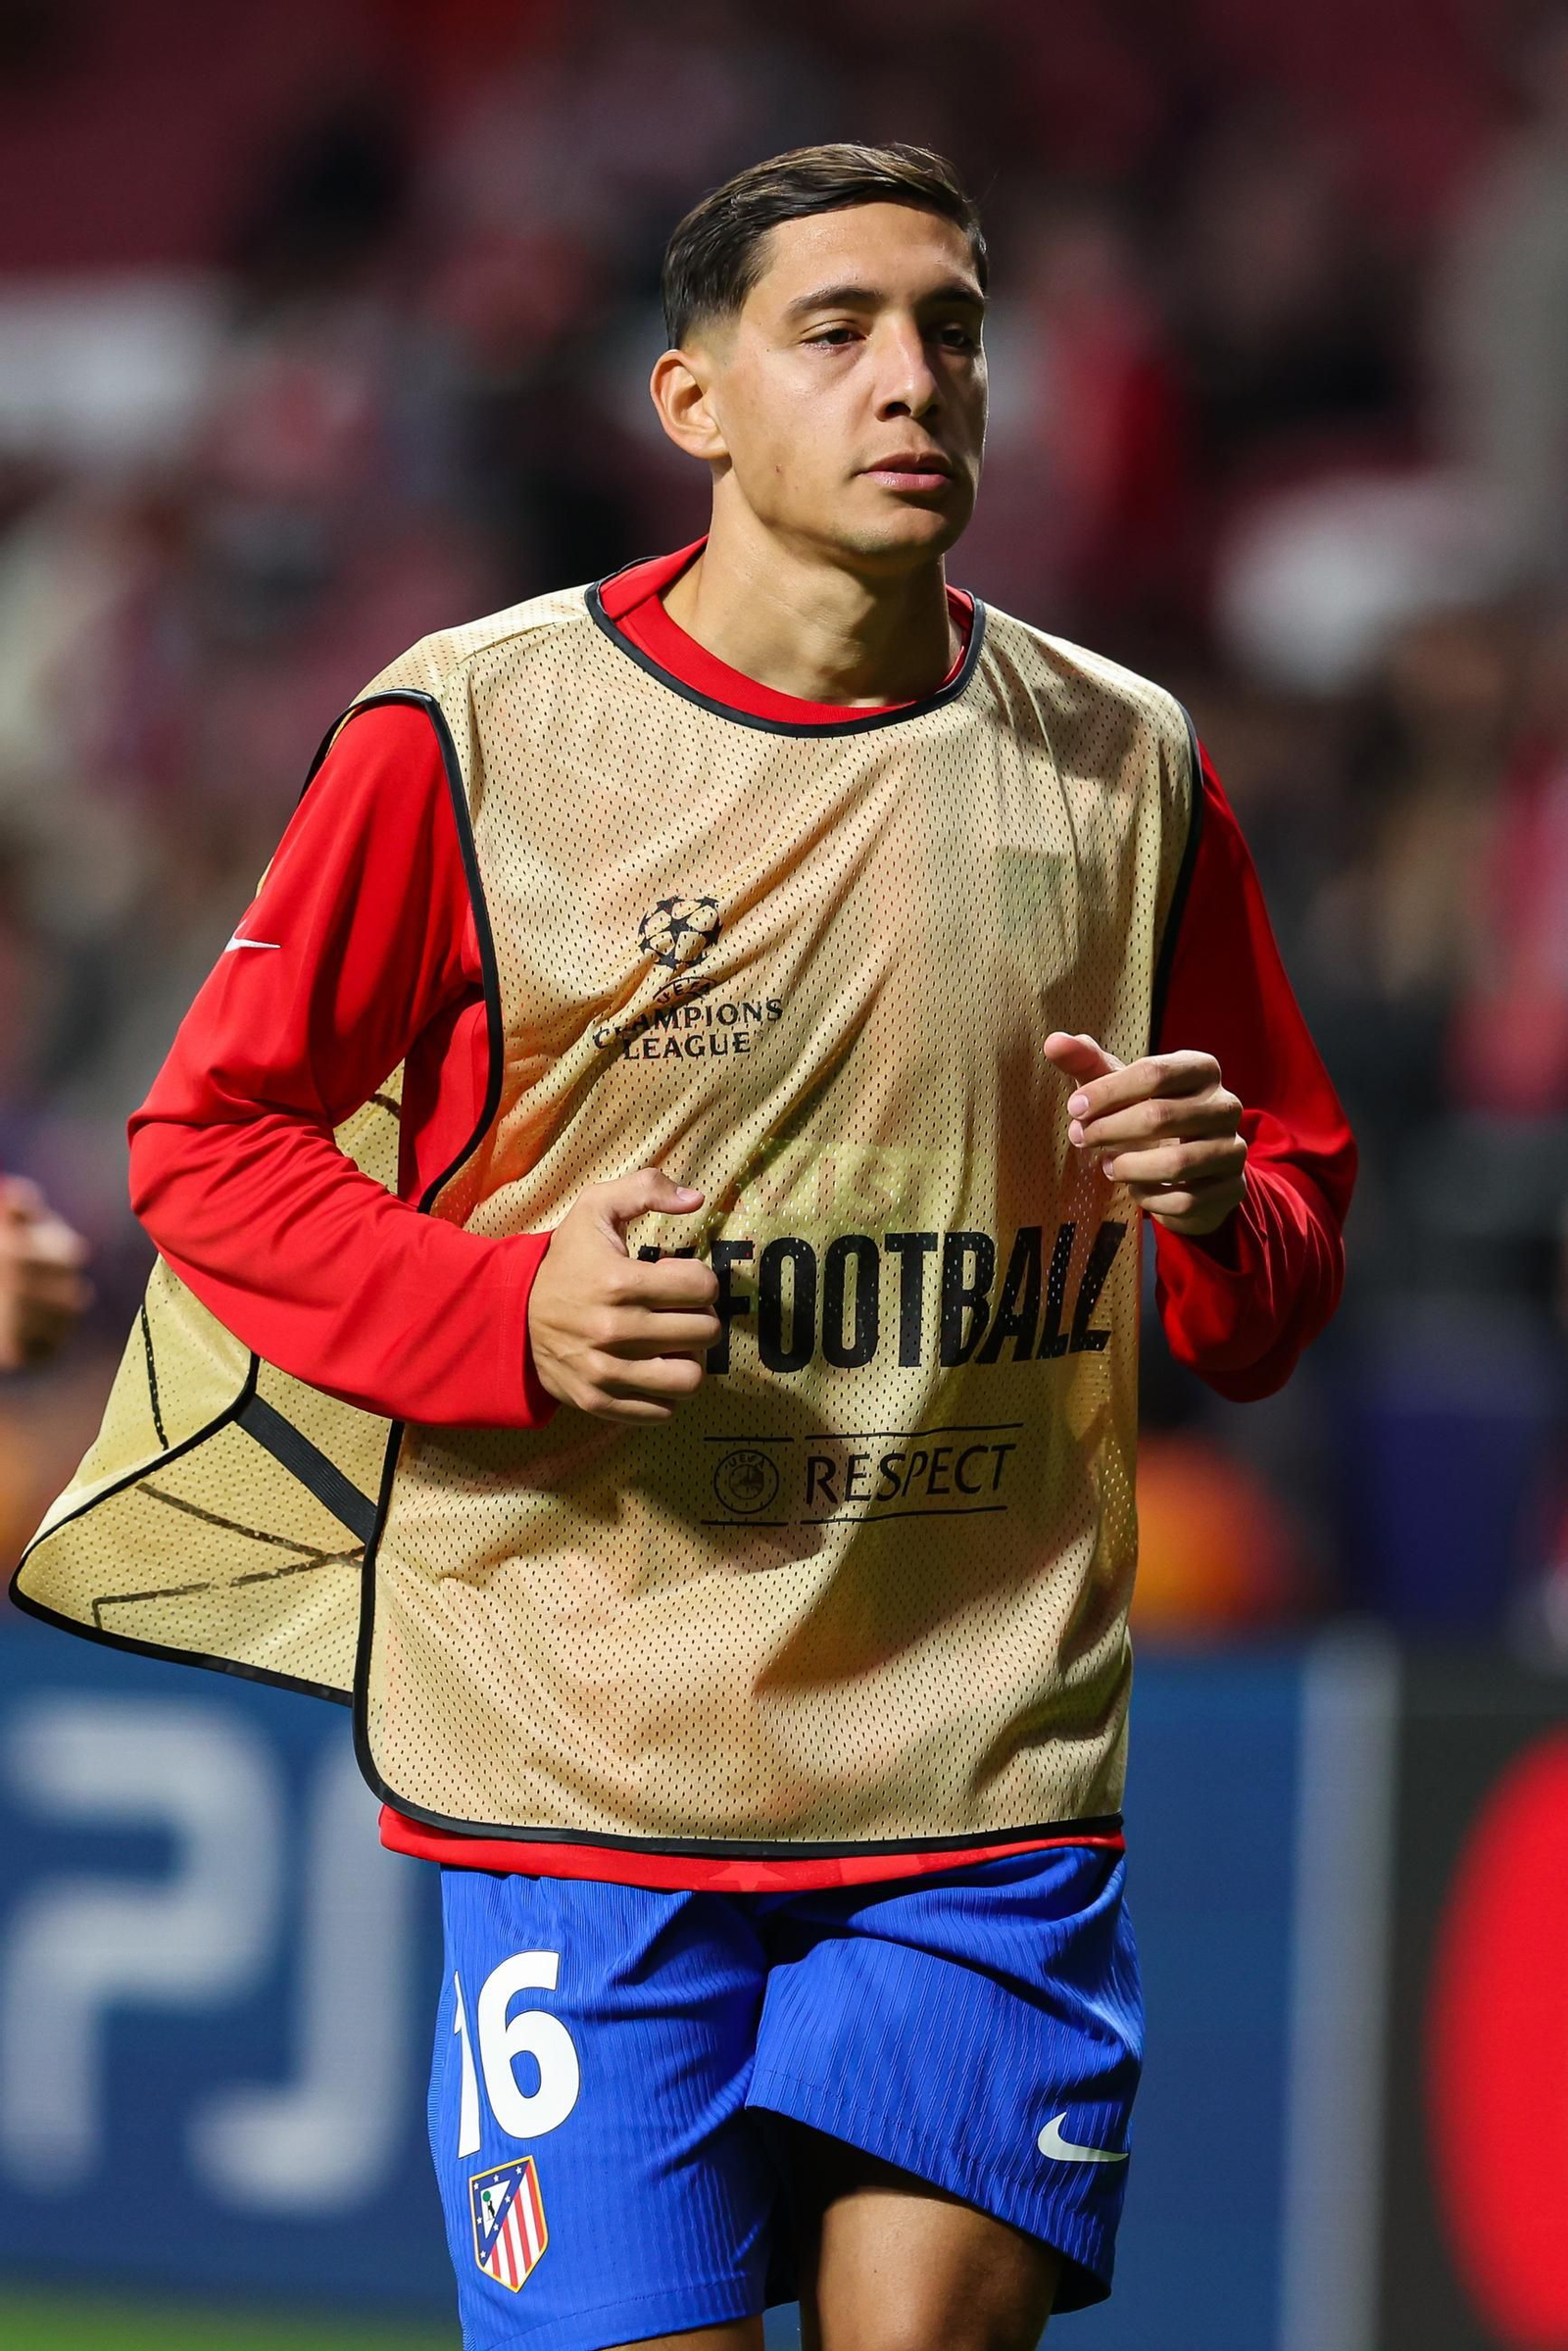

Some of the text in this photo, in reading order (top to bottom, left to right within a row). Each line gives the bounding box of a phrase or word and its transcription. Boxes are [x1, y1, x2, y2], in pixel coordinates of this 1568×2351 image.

[593, 998, 784, 1049] CAMPIONS
[622, 1031, 752, 1060] LEAGUE
[638, 1221, 1128, 1376] FOOTBALL
[805, 1443, 1017, 1505] RESPECT
[453, 1948, 581, 2160] 16
